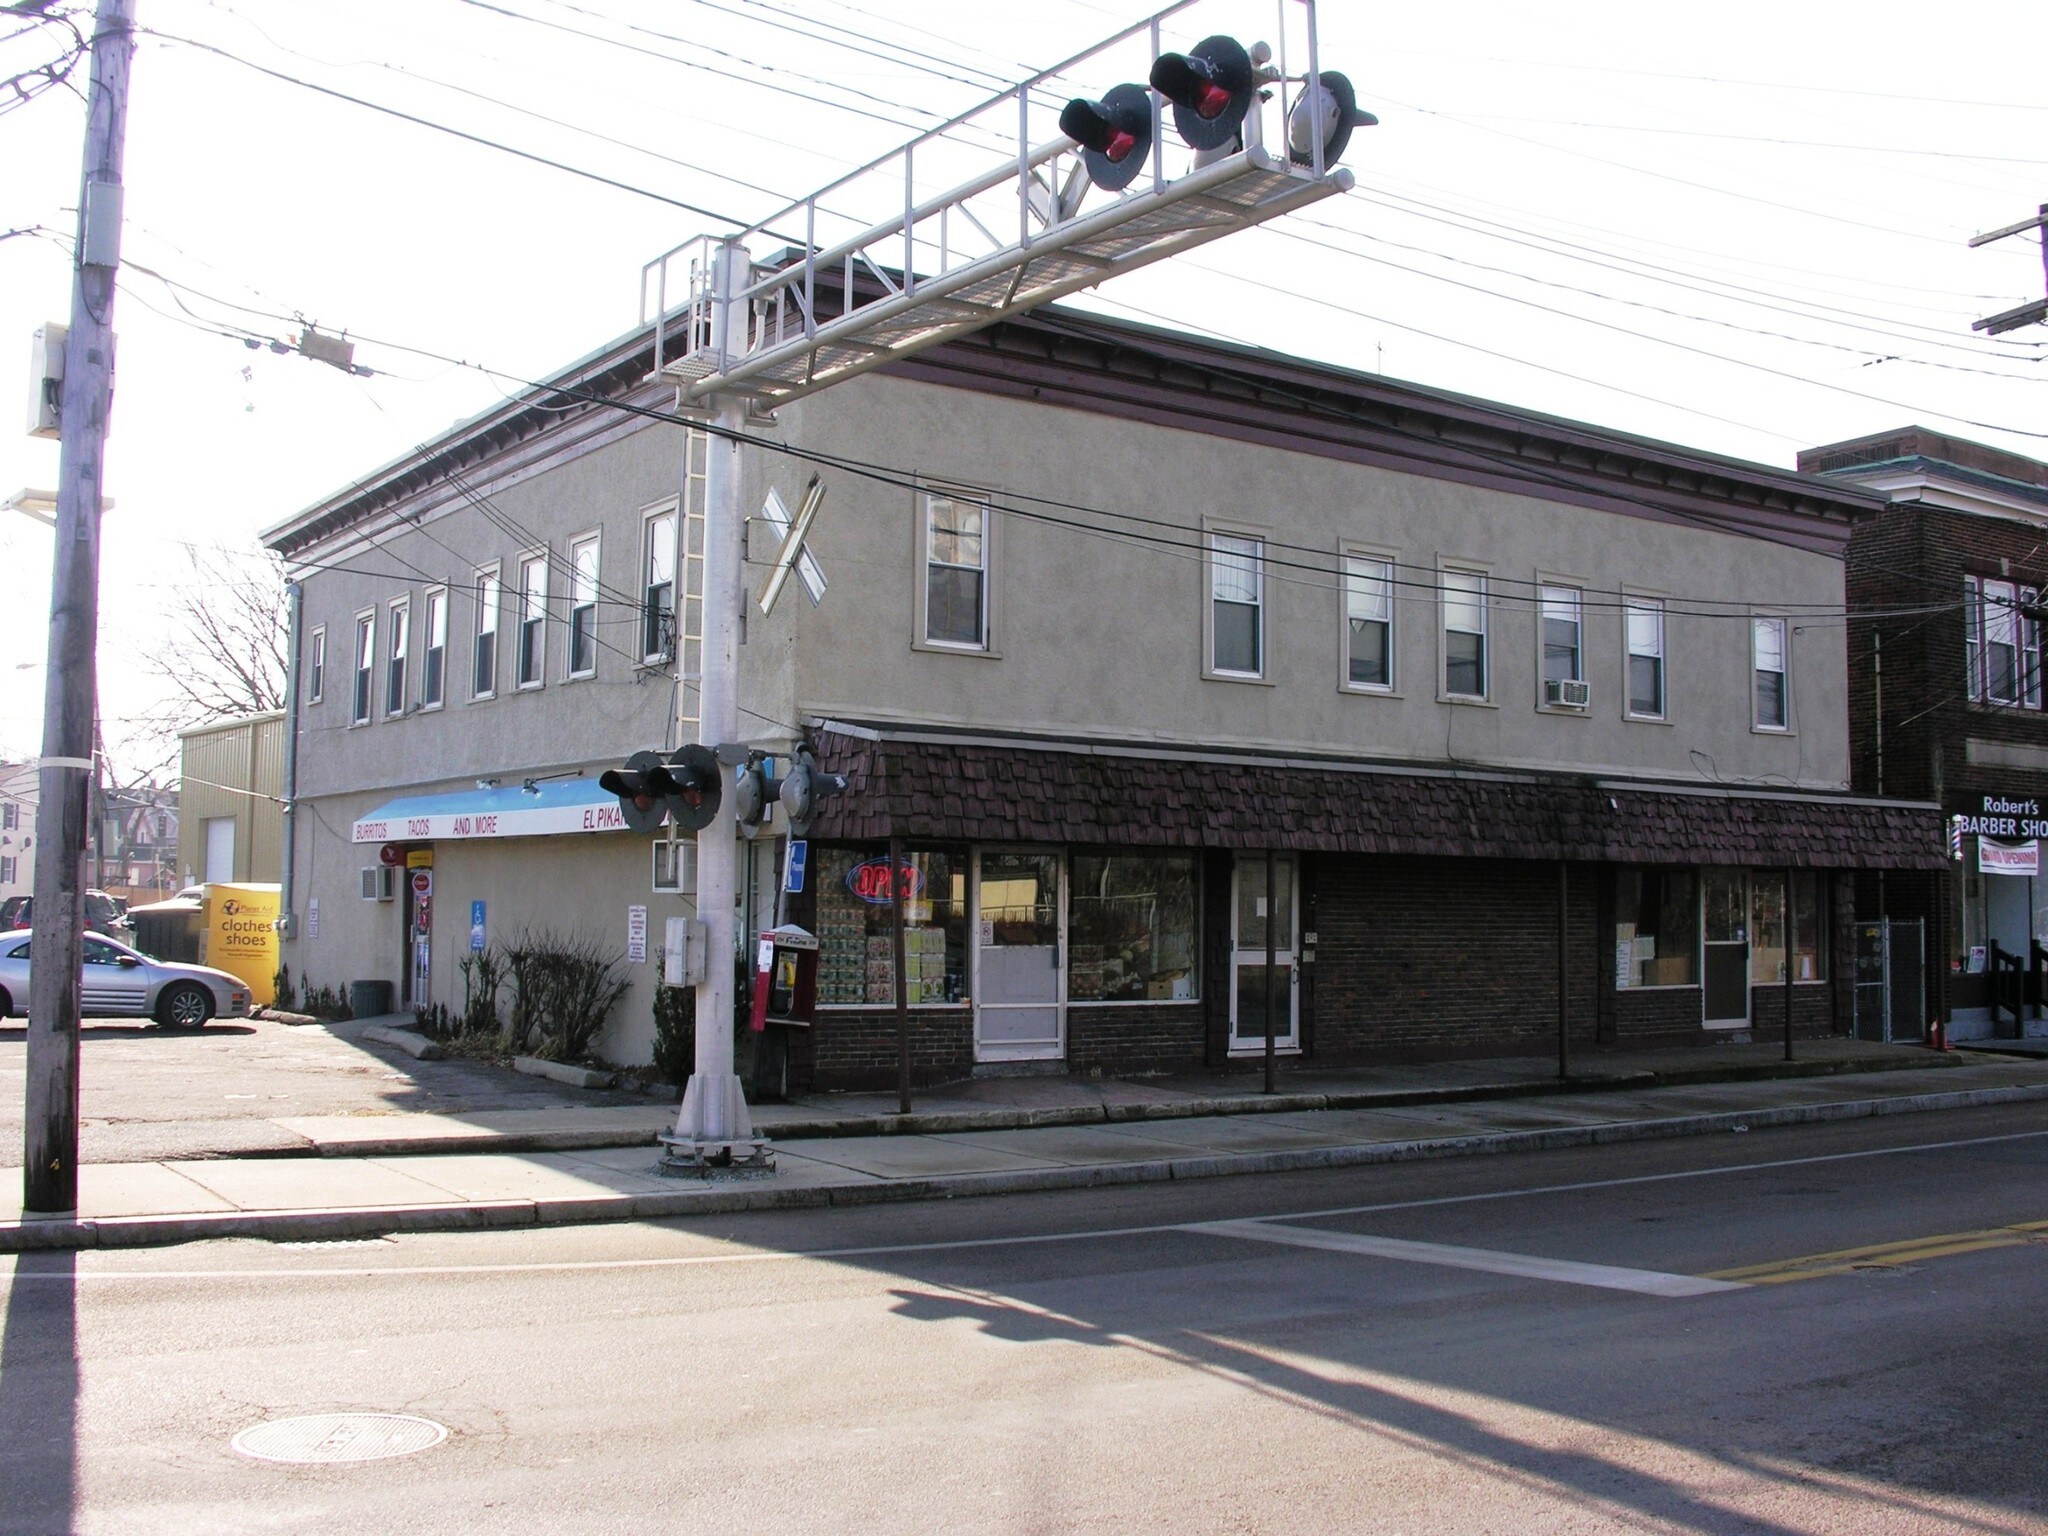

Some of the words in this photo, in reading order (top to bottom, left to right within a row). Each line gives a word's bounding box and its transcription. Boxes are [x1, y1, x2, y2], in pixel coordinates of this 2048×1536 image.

[1983, 796, 2039, 815] Robert's
[356, 822, 387, 840] BURRITOS
[408, 819, 430, 836] TACOS
[453, 817, 471, 835] AND
[475, 816, 497, 834] MORE
[583, 809, 595, 829] EL
[597, 806, 624, 828] PIKA
[1960, 815, 2017, 836] BARBER
[855, 865, 917, 898] OPN
[221, 918, 273, 933] clothes
[226, 932, 266, 946] shoes
